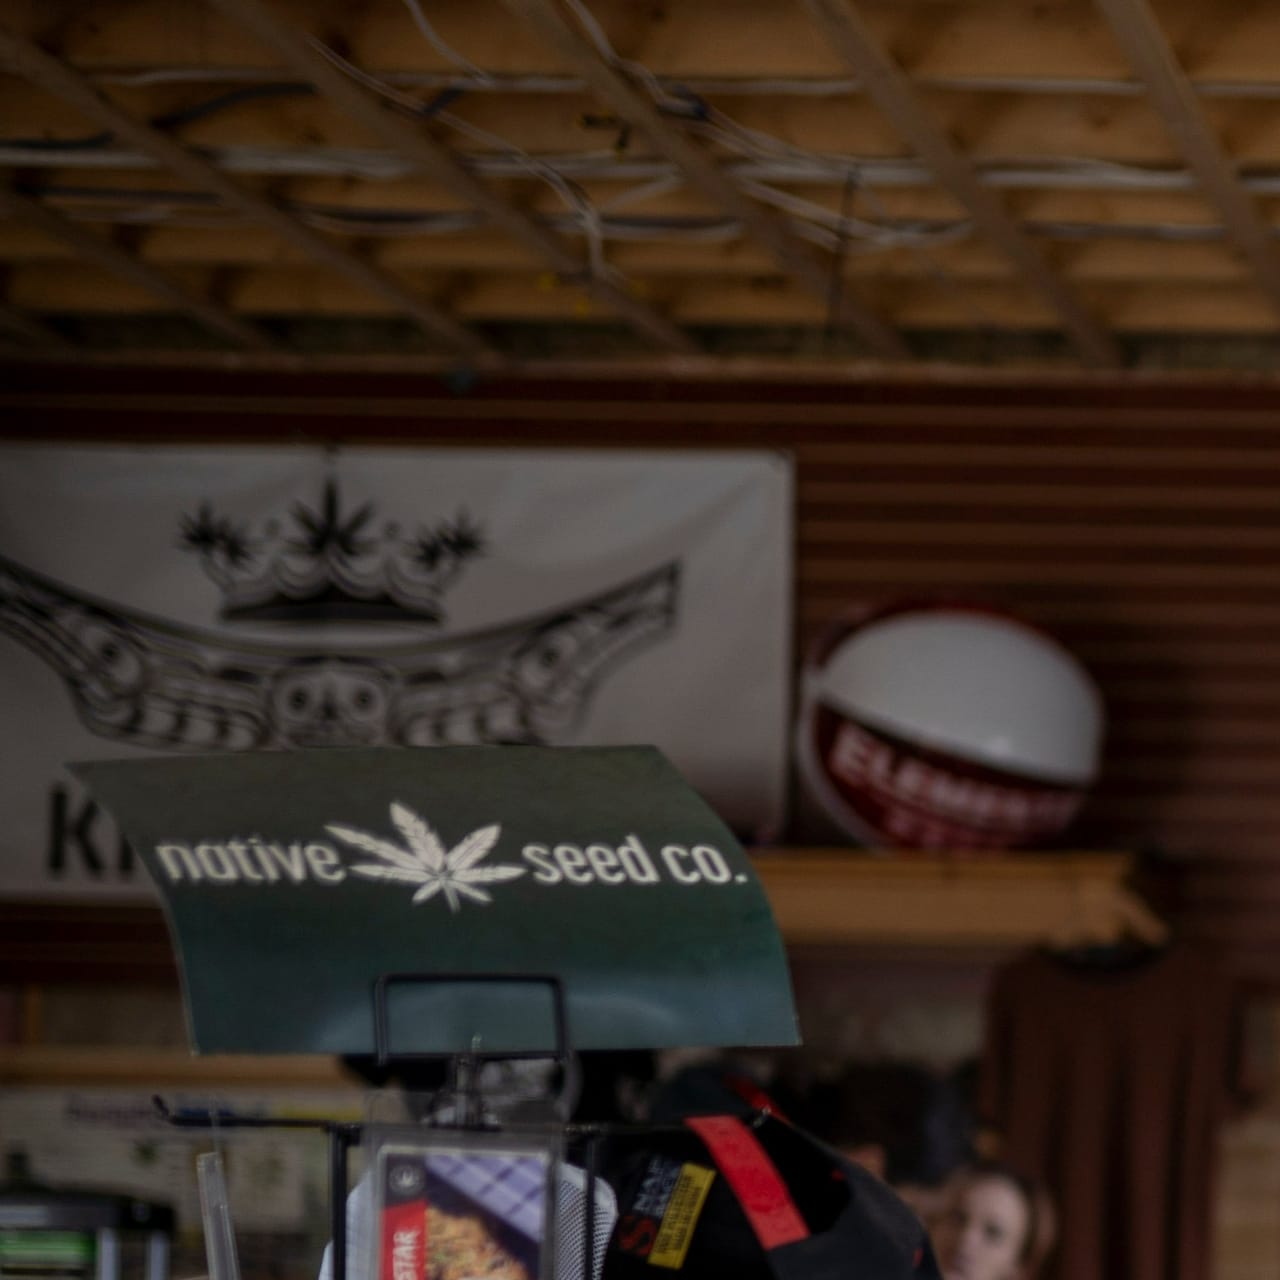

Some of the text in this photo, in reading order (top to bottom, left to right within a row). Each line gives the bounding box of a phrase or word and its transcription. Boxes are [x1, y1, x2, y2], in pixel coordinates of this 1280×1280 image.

[154, 835, 748, 888] native seed co.
